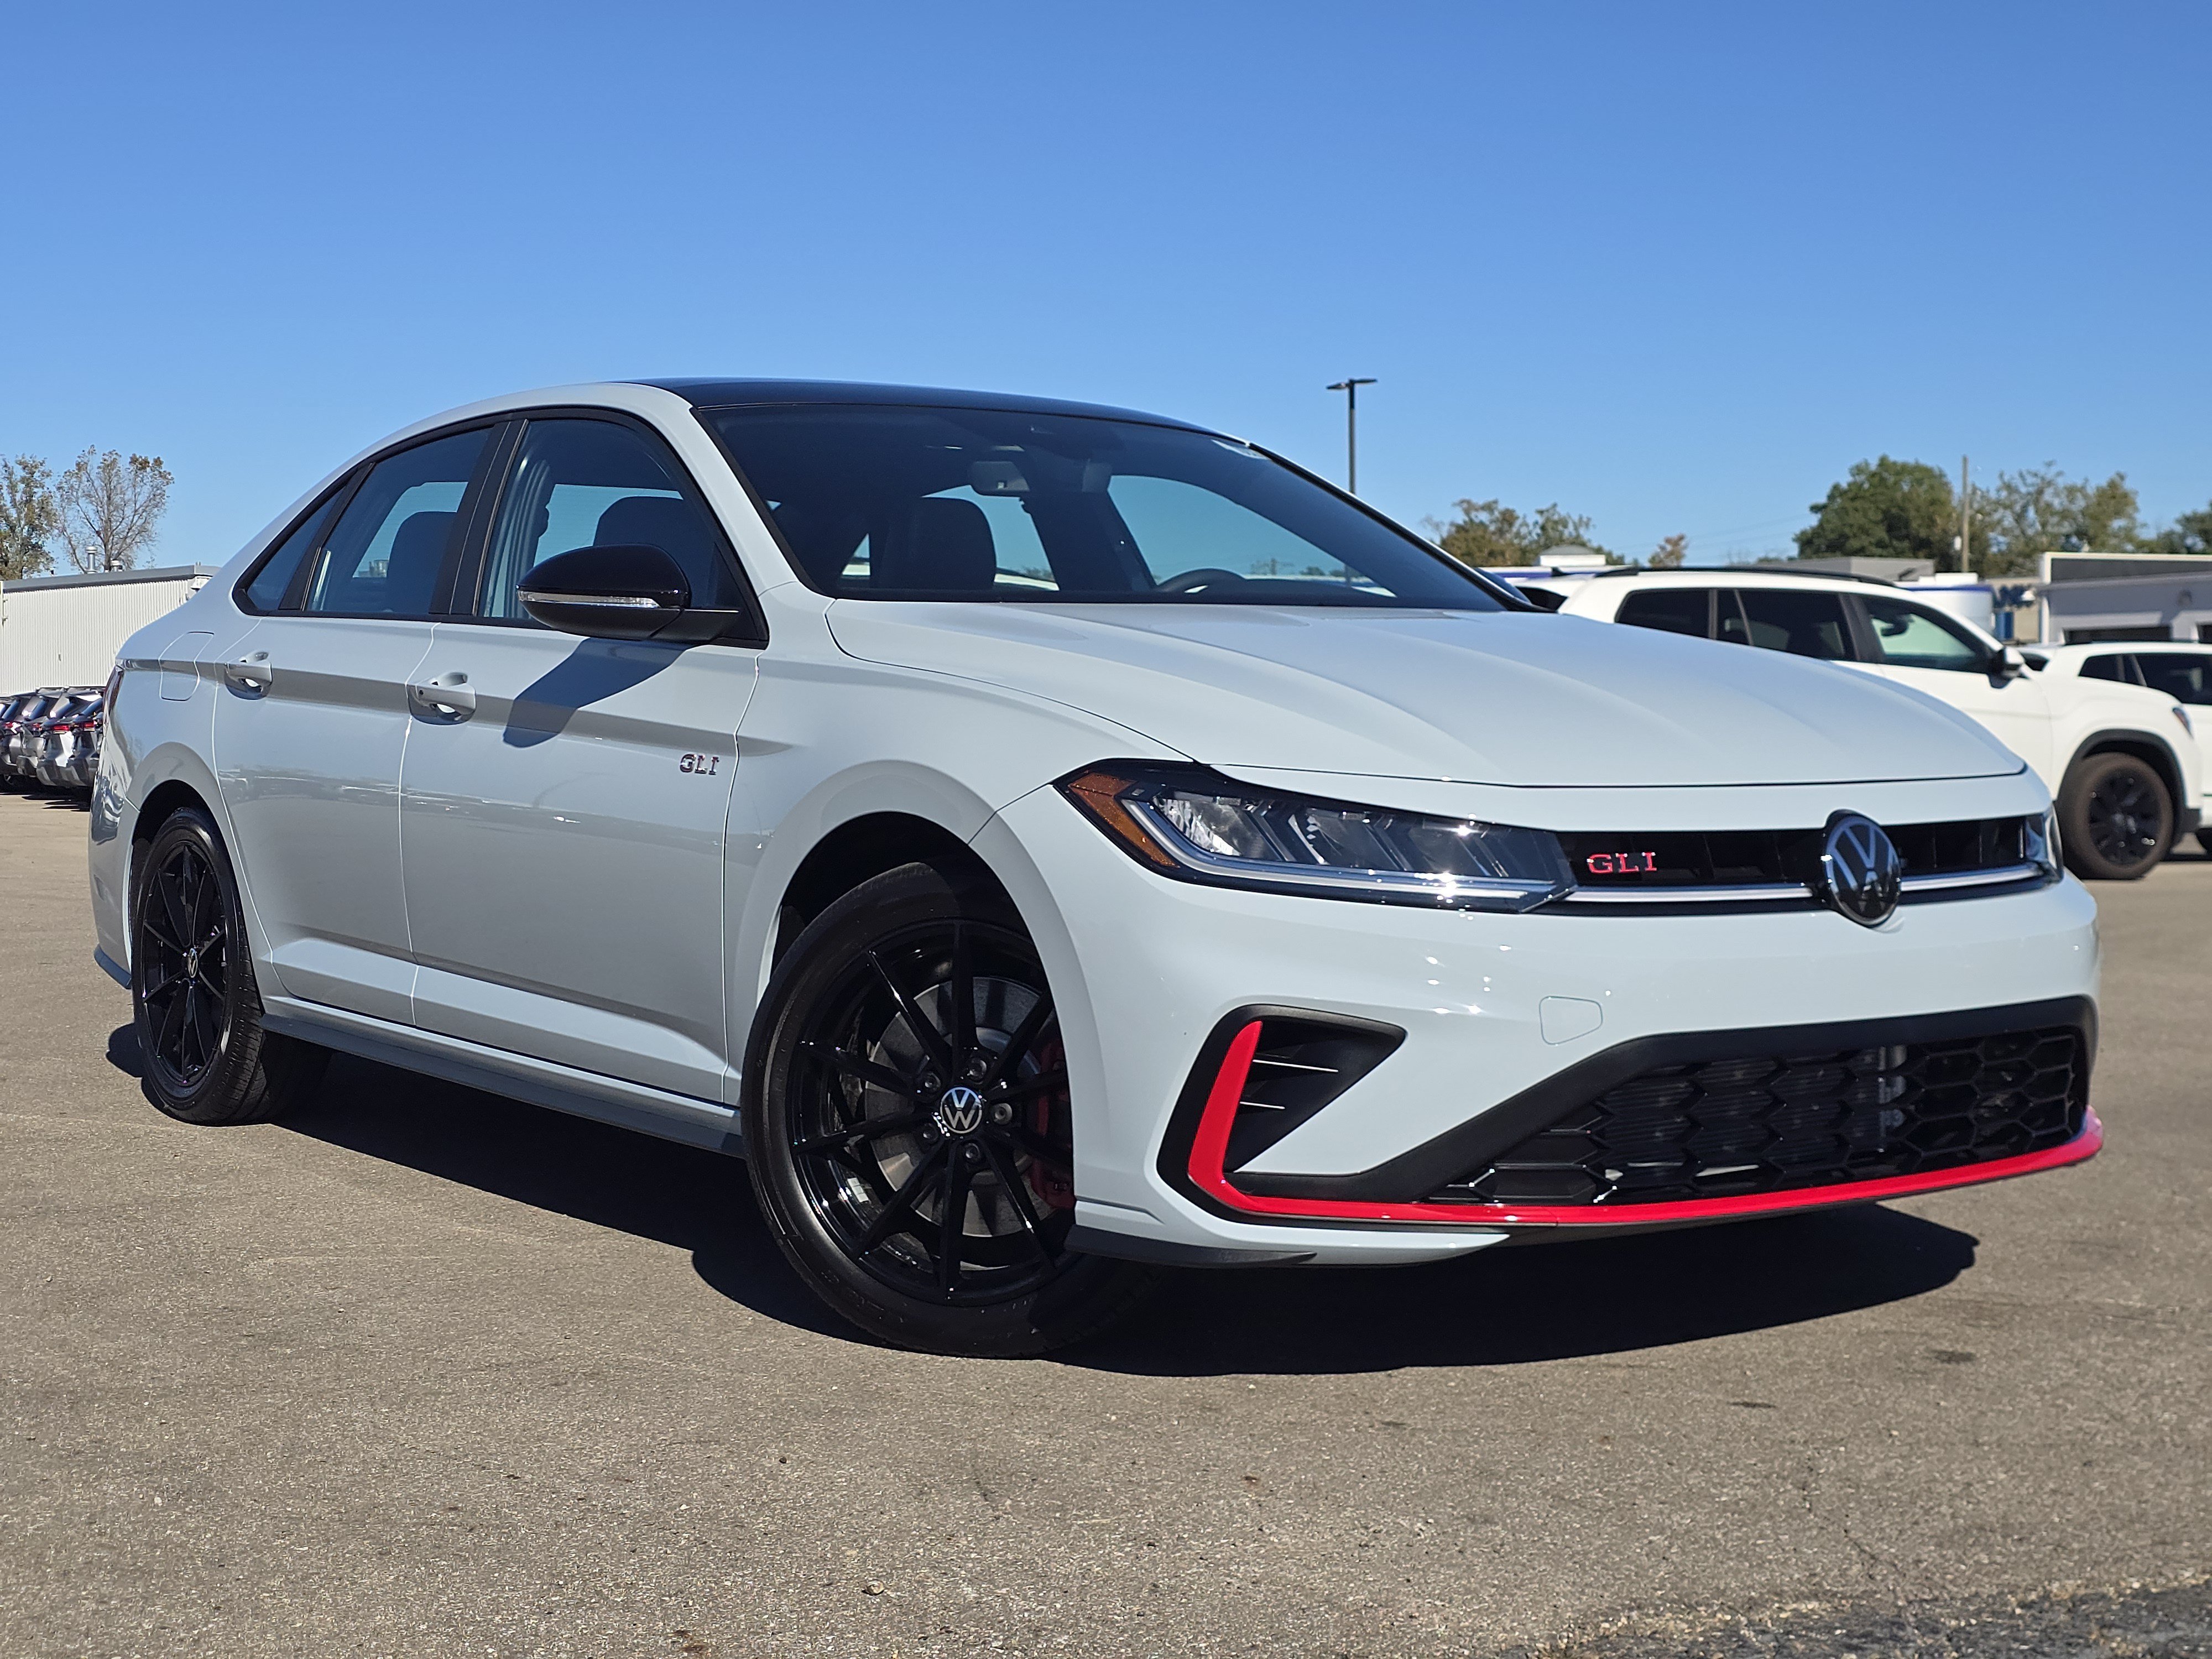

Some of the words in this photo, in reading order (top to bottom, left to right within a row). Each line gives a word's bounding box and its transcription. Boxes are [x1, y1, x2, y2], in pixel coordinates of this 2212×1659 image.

[680, 753, 719, 775] GLI
[1586, 852, 1657, 874] GLI
[942, 1088, 982, 1133] VW
